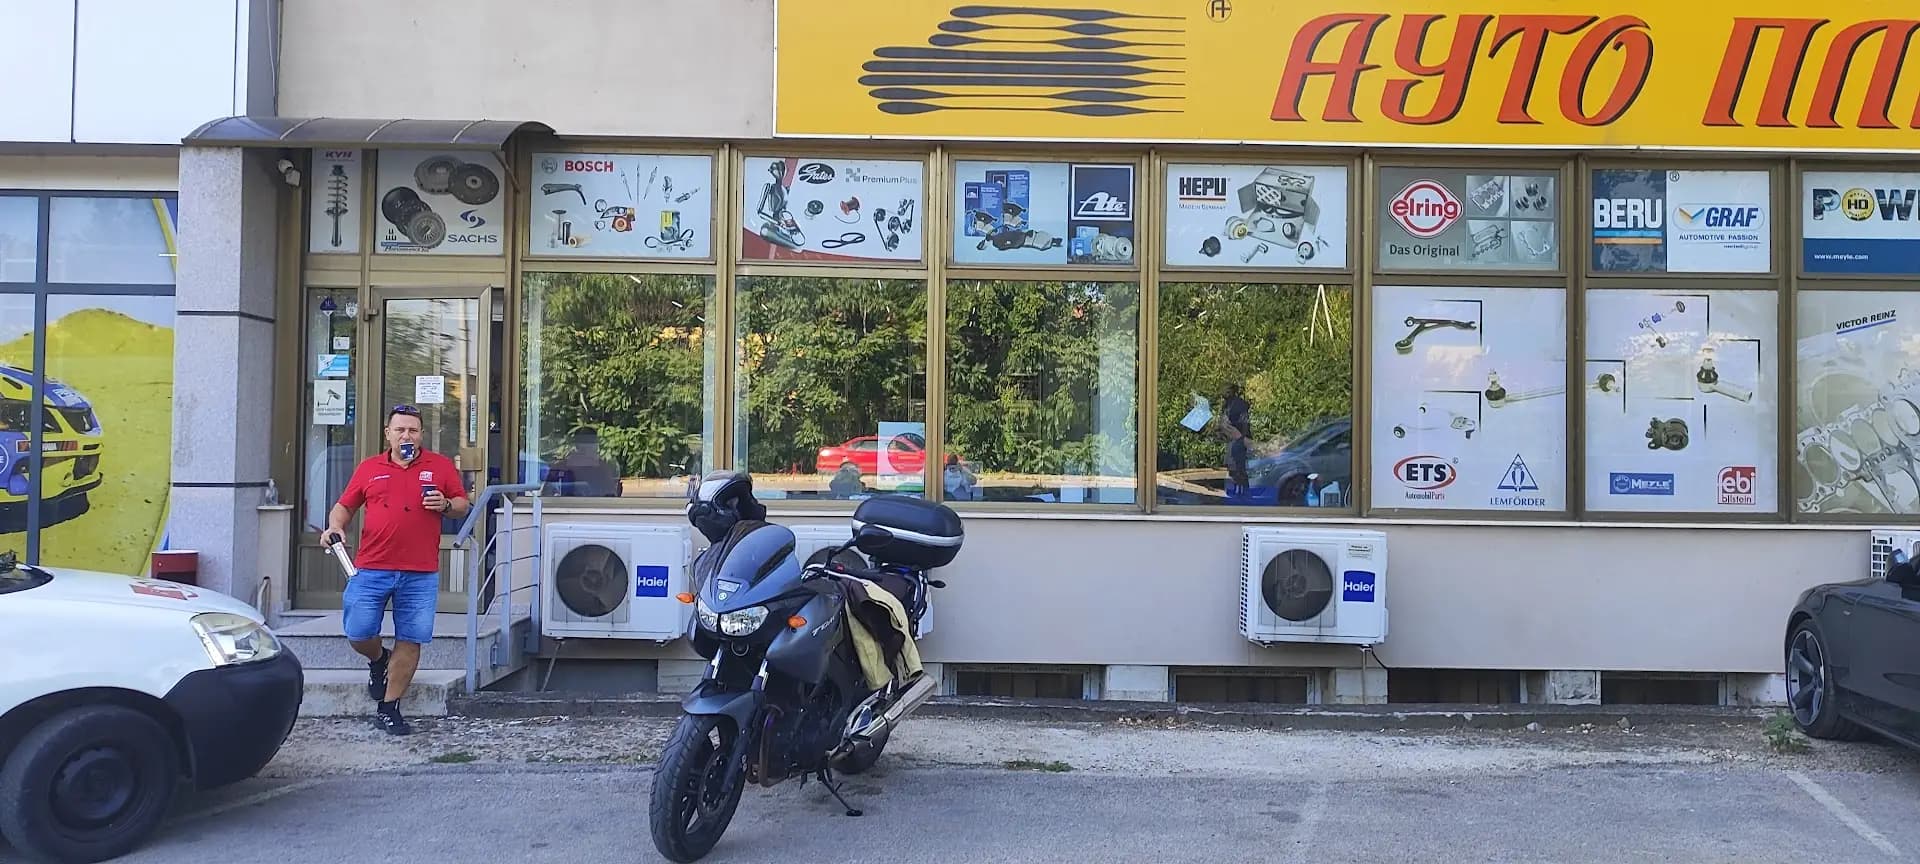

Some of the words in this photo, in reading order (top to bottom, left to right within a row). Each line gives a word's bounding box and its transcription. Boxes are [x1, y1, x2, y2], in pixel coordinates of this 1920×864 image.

[1270, 13, 1654, 127] АУТО
[1701, 17, 1920, 130] ПЛ
[564, 160, 614, 173] BOSCH
[799, 165, 834, 181] Gates
[1179, 177, 1226, 196] HEPU
[1393, 198, 1458, 219] elring
[1594, 199, 1662, 228] BERU
[1706, 207, 1758, 227] GRAF
[448, 234, 497, 243] SACHS
[1389, 244, 1410, 255] Das
[1413, 244, 1459, 258] Original
[1836, 316, 1868, 330] VICTOR
[1870, 309, 1896, 322] REINZ
[1406, 463, 1446, 482] ETS
[1490, 496, 1545, 506] LEMFÖRDER
[637, 576, 668, 587] Haier
[1344, 581, 1374, 592] Haier
